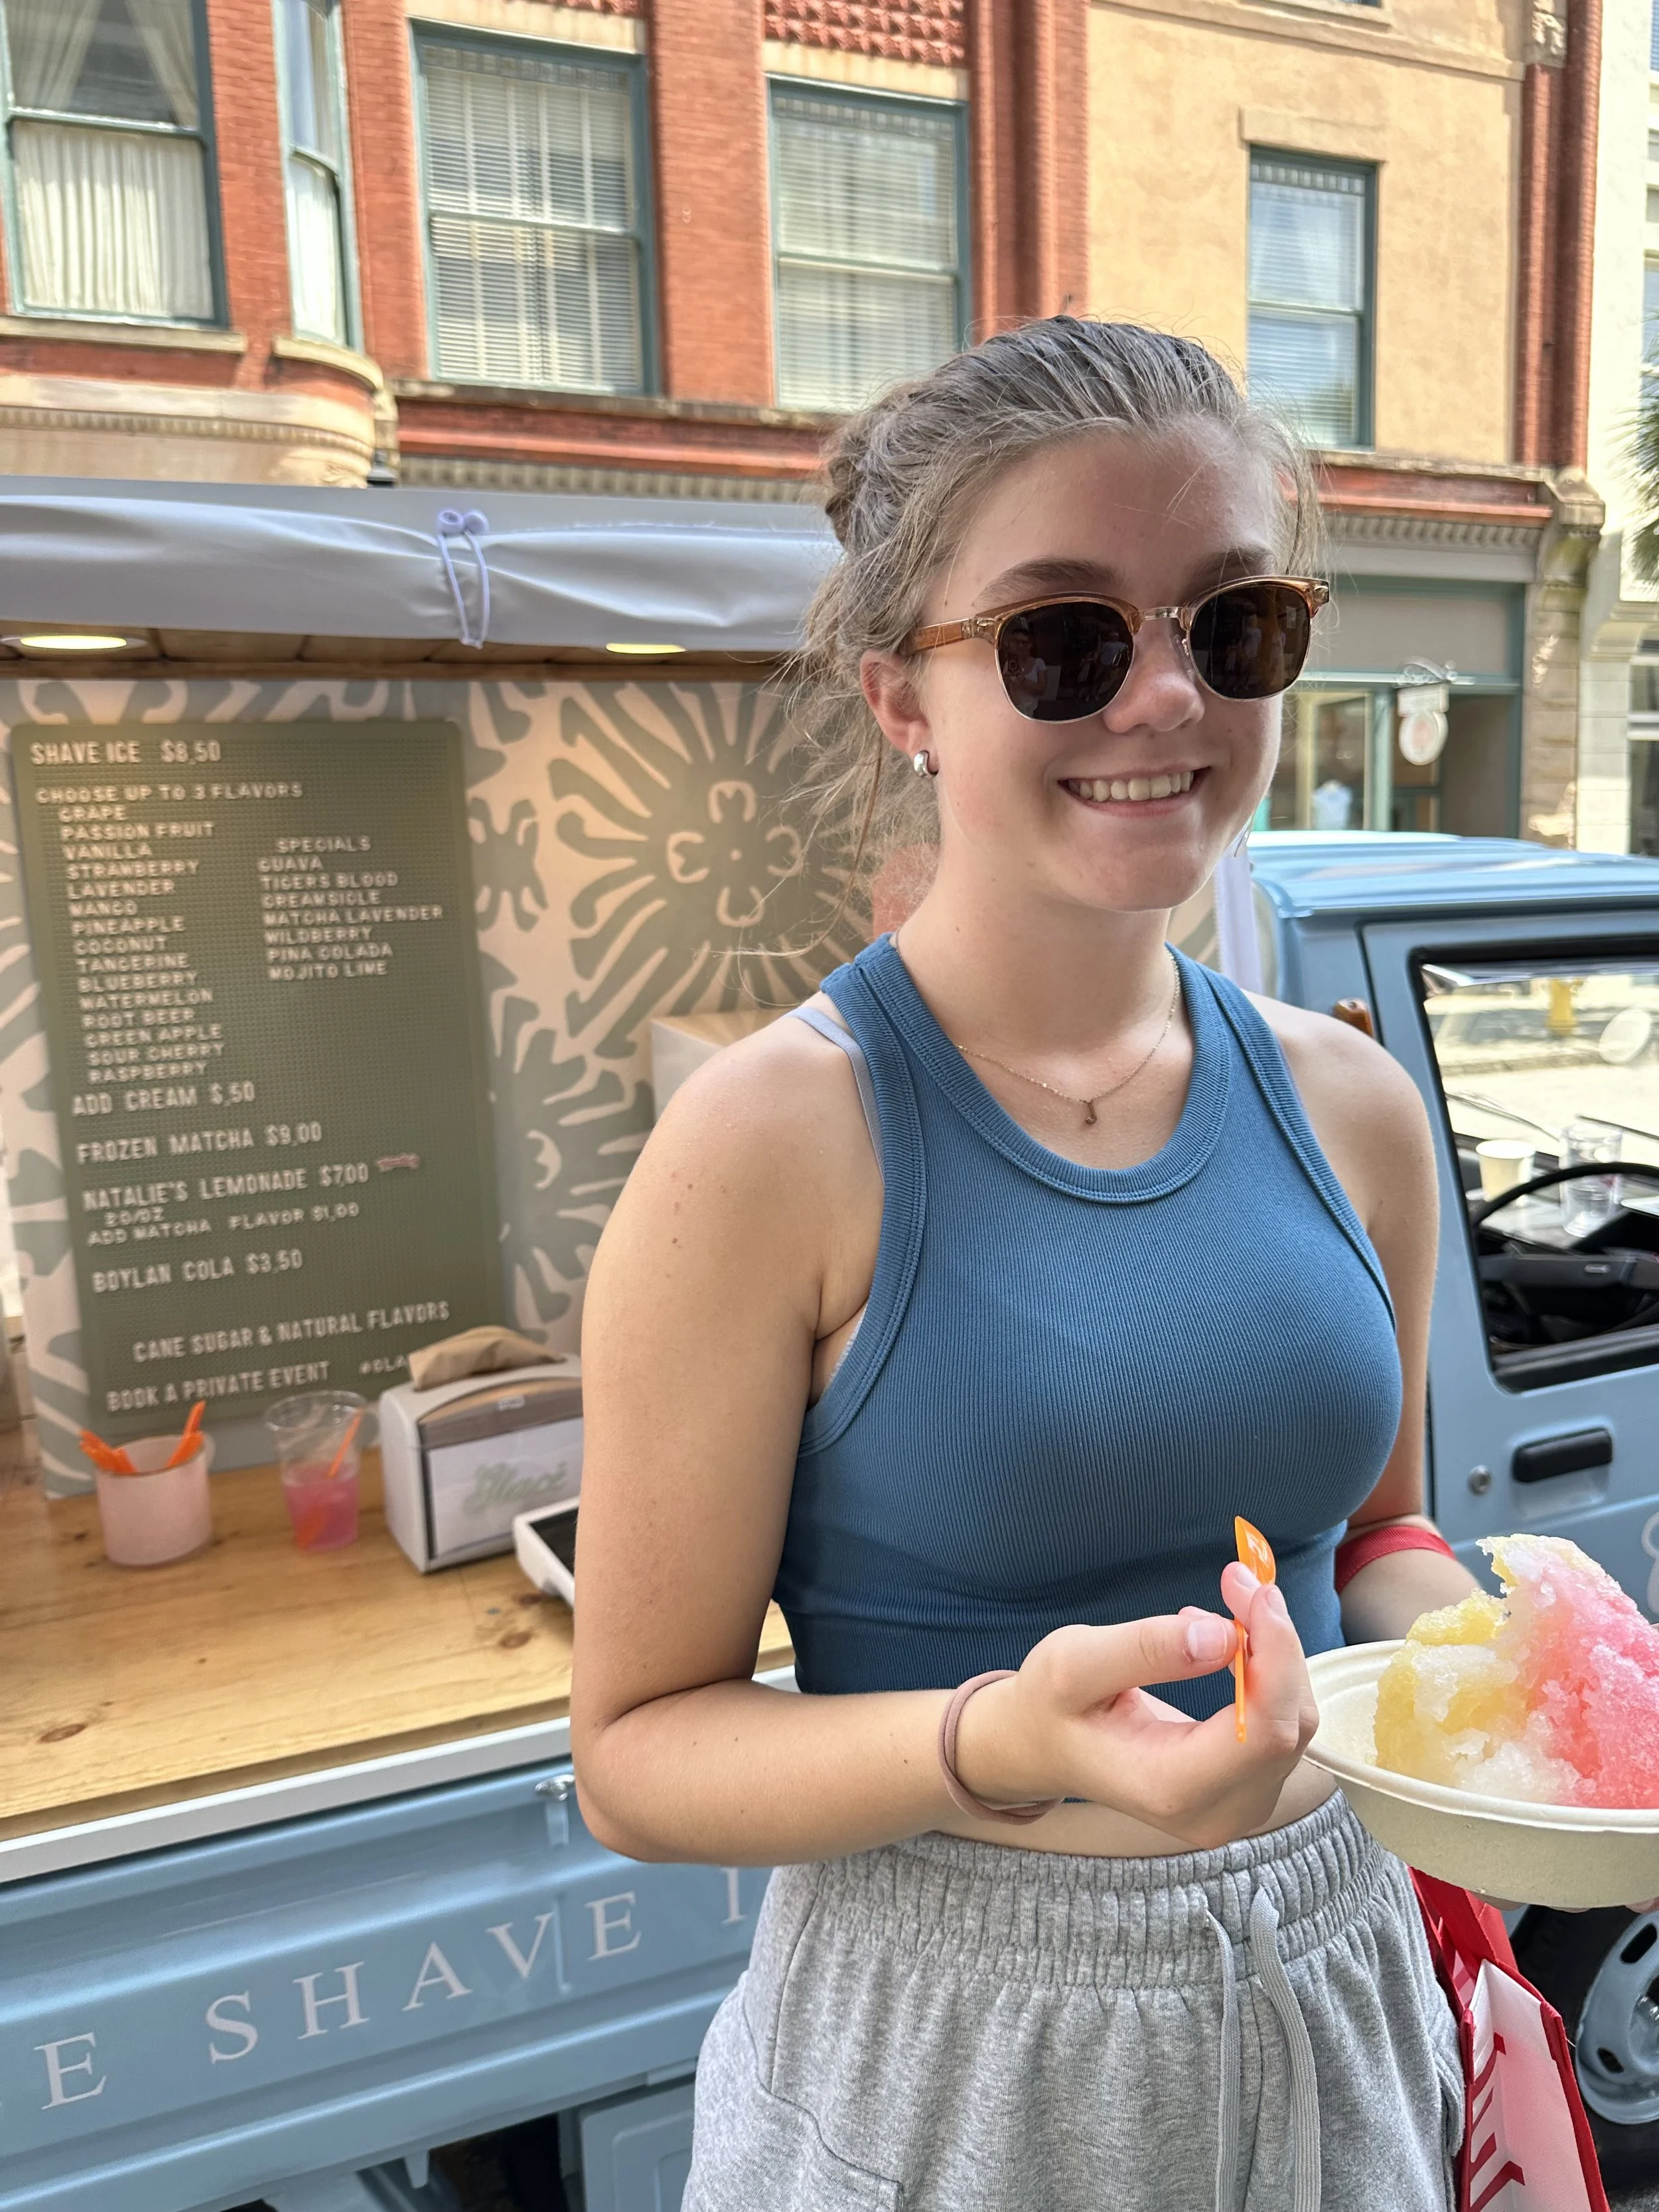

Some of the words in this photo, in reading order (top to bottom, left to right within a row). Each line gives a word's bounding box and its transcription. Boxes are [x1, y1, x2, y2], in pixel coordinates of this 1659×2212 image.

[31, 741, 100, 765] SHAVE
[106, 740, 141, 763] ICE
[161, 739, 222, 765] $8.50
[35, 786, 117, 804] CHOOSE
[124, 785, 152, 802] UP
[158, 784, 186, 800] TO
[193, 784, 206, 800] 3
[210, 782, 303, 800] FLAVORS
[58, 805, 127, 822] GRAPE
[60, 823, 150, 841] PASSION
[155, 821, 214, 839] FRUIT
[62, 842, 153, 861] VANILLA
[276, 835, 371, 853] SPECIALS
[66, 859, 199, 880] STRAWBERRY
[257, 855, 323, 873] GUAVA
[67, 880, 175, 899] LAVENDER
[259, 873, 330, 891] TIGERS
[335, 870, 398, 888] BLOOD
[68, 900, 138, 917] MANGO
[263, 889, 382, 909] CREAMSICLE
[263, 909, 340, 926] MATCHA
[344, 904, 443, 924] LAVENDER
[72, 916, 186, 936] PINEAPPLE
[264, 925, 372, 945] WILDBERRY
[73, 935, 166, 955] COCONUT
[266, 946, 313, 962] PINA
[317, 941, 394, 960] COLADA
[76, 952, 188, 974] TANGERINE
[267, 963, 338, 981] MOJITO
[343, 960, 388, 978] LIME
[78, 970, 198, 993] BLUEBERRY
[80, 989, 212, 1009] WATERMELON
[82, 1011, 135, 1029] ROOT
[142, 1007, 194, 1025] BEER
[86, 1030, 151, 1047] GREEN
[157, 1023, 222, 1041] APPLE
[88, 1049, 140, 1065] SOUR
[146, 1041, 225, 1062] CHERRY
[88, 1062, 206, 1082] RASPBERRY
[72, 1092, 113, 1116] ADD
[125, 1085, 198, 1112] CREAM
[76, 1136, 159, 1165] FROZEN
[168, 1127, 254, 1156] MATCHA
[82, 1180, 188, 1212] NATALIE'S
[199, 1167, 308, 1201] LEMONADE
[86, 1228, 127, 1247] ADD
[133, 1218, 212, 1240] MATCHA
[228, 1207, 305, 1230] FLAVOR
[92, 1262, 172, 1293] BOYLAN
[182, 1256, 235, 1282] COLA
[133, 1336, 186, 1363] CANE
[189, 1327, 253, 1355] SUGAR
[257, 1325, 273, 1346] &
[276, 1312, 363, 1342] NATURAL
[366, 1300, 450, 1331] FLAVORS
[106, 1386, 160, 1412] BOOK
[164, 1382, 179, 1404] A
[182, 1370, 265, 1401] PRIVATE
[267, 1361, 331, 1389] EVENT
[204, 1891, 642, 2064] SHAVE
